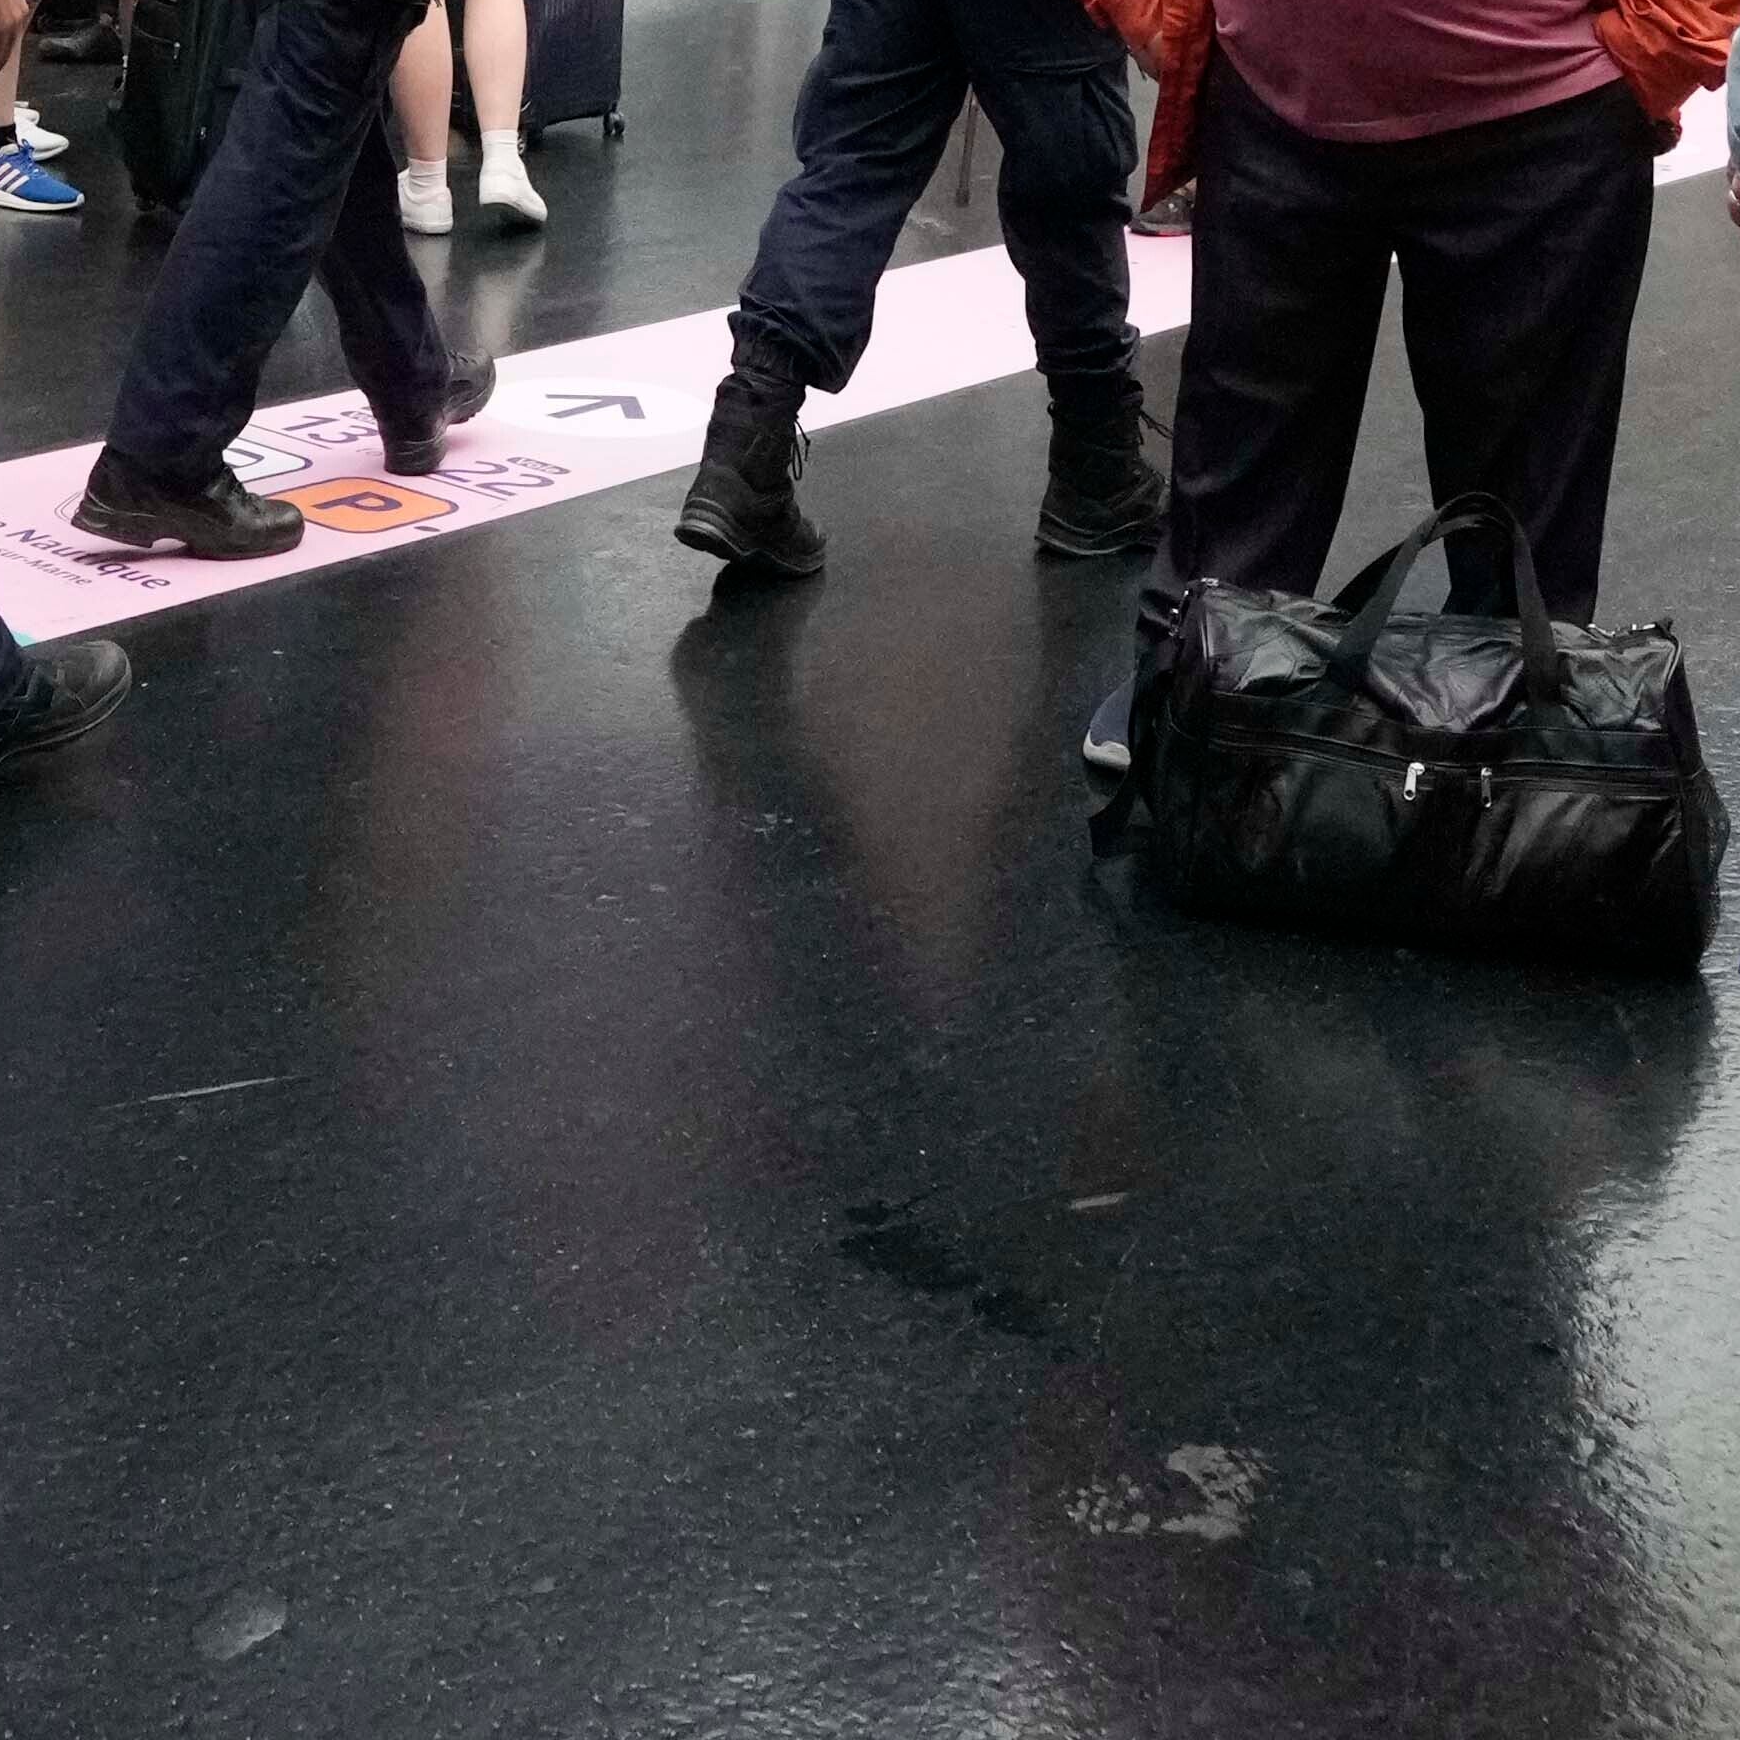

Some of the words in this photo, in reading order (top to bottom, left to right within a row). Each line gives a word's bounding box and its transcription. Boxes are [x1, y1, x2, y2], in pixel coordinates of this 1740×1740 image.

[436, 459, 556, 498] 22
[312, 491, 404, 512] P
[6, 528, 172, 590] Nautique
